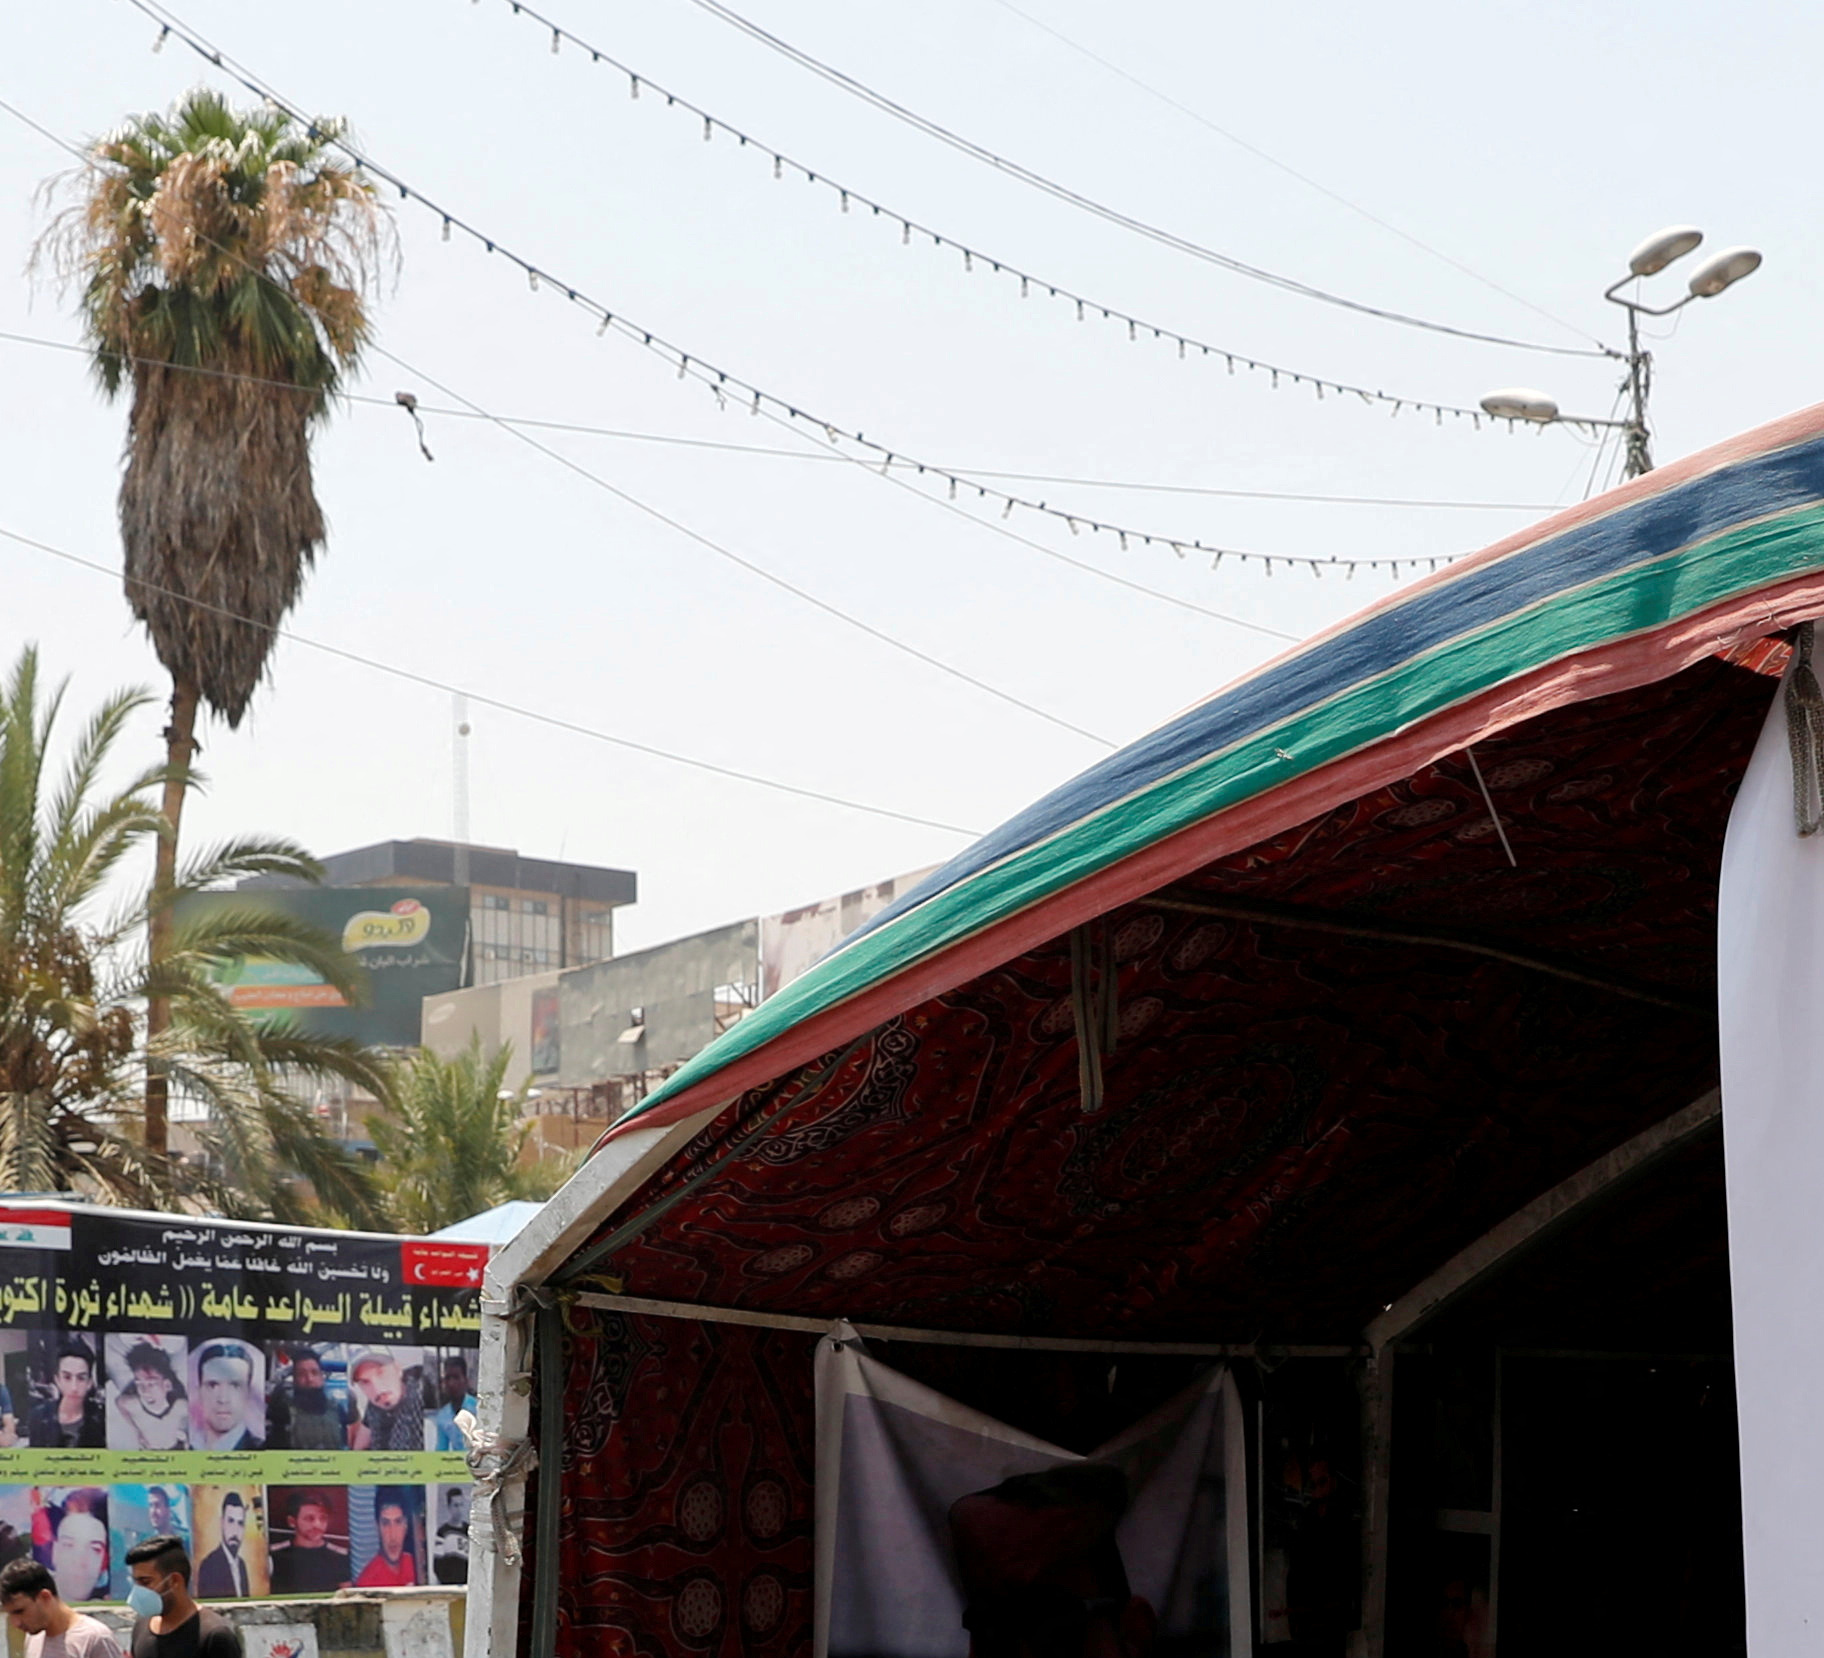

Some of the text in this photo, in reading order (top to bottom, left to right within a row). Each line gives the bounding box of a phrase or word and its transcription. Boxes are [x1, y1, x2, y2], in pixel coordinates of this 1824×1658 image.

[53, 1277, 100, 1328] ثورة
[201, 1282, 259, 1321] عامة
[265, 1289, 352, 1334] السواعد
[358, 1291, 413, 1340] قبيلة
